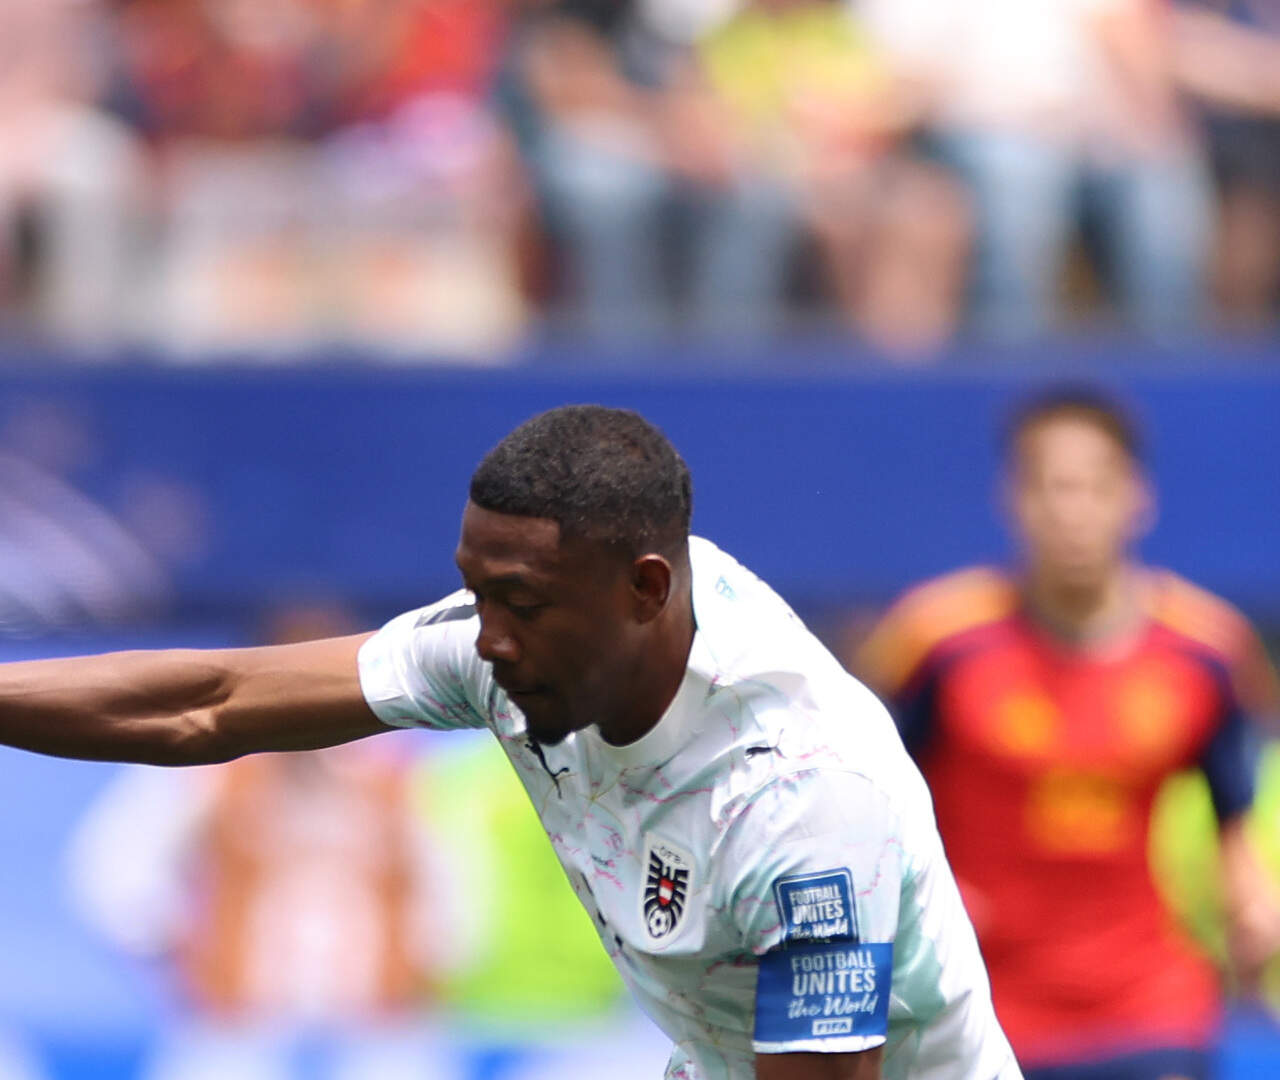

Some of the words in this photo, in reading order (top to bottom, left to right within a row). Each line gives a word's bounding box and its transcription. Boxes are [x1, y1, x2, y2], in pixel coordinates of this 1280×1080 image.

[789, 885, 842, 906] FOOTBALL
[792, 899, 845, 924] UNITES
[791, 950, 875, 973] FOOTBALL
[793, 968, 876, 997] UNITES
[788, 998, 822, 1019] the
[823, 992, 879, 1016] World
[815, 1021, 850, 1034] FIFA
